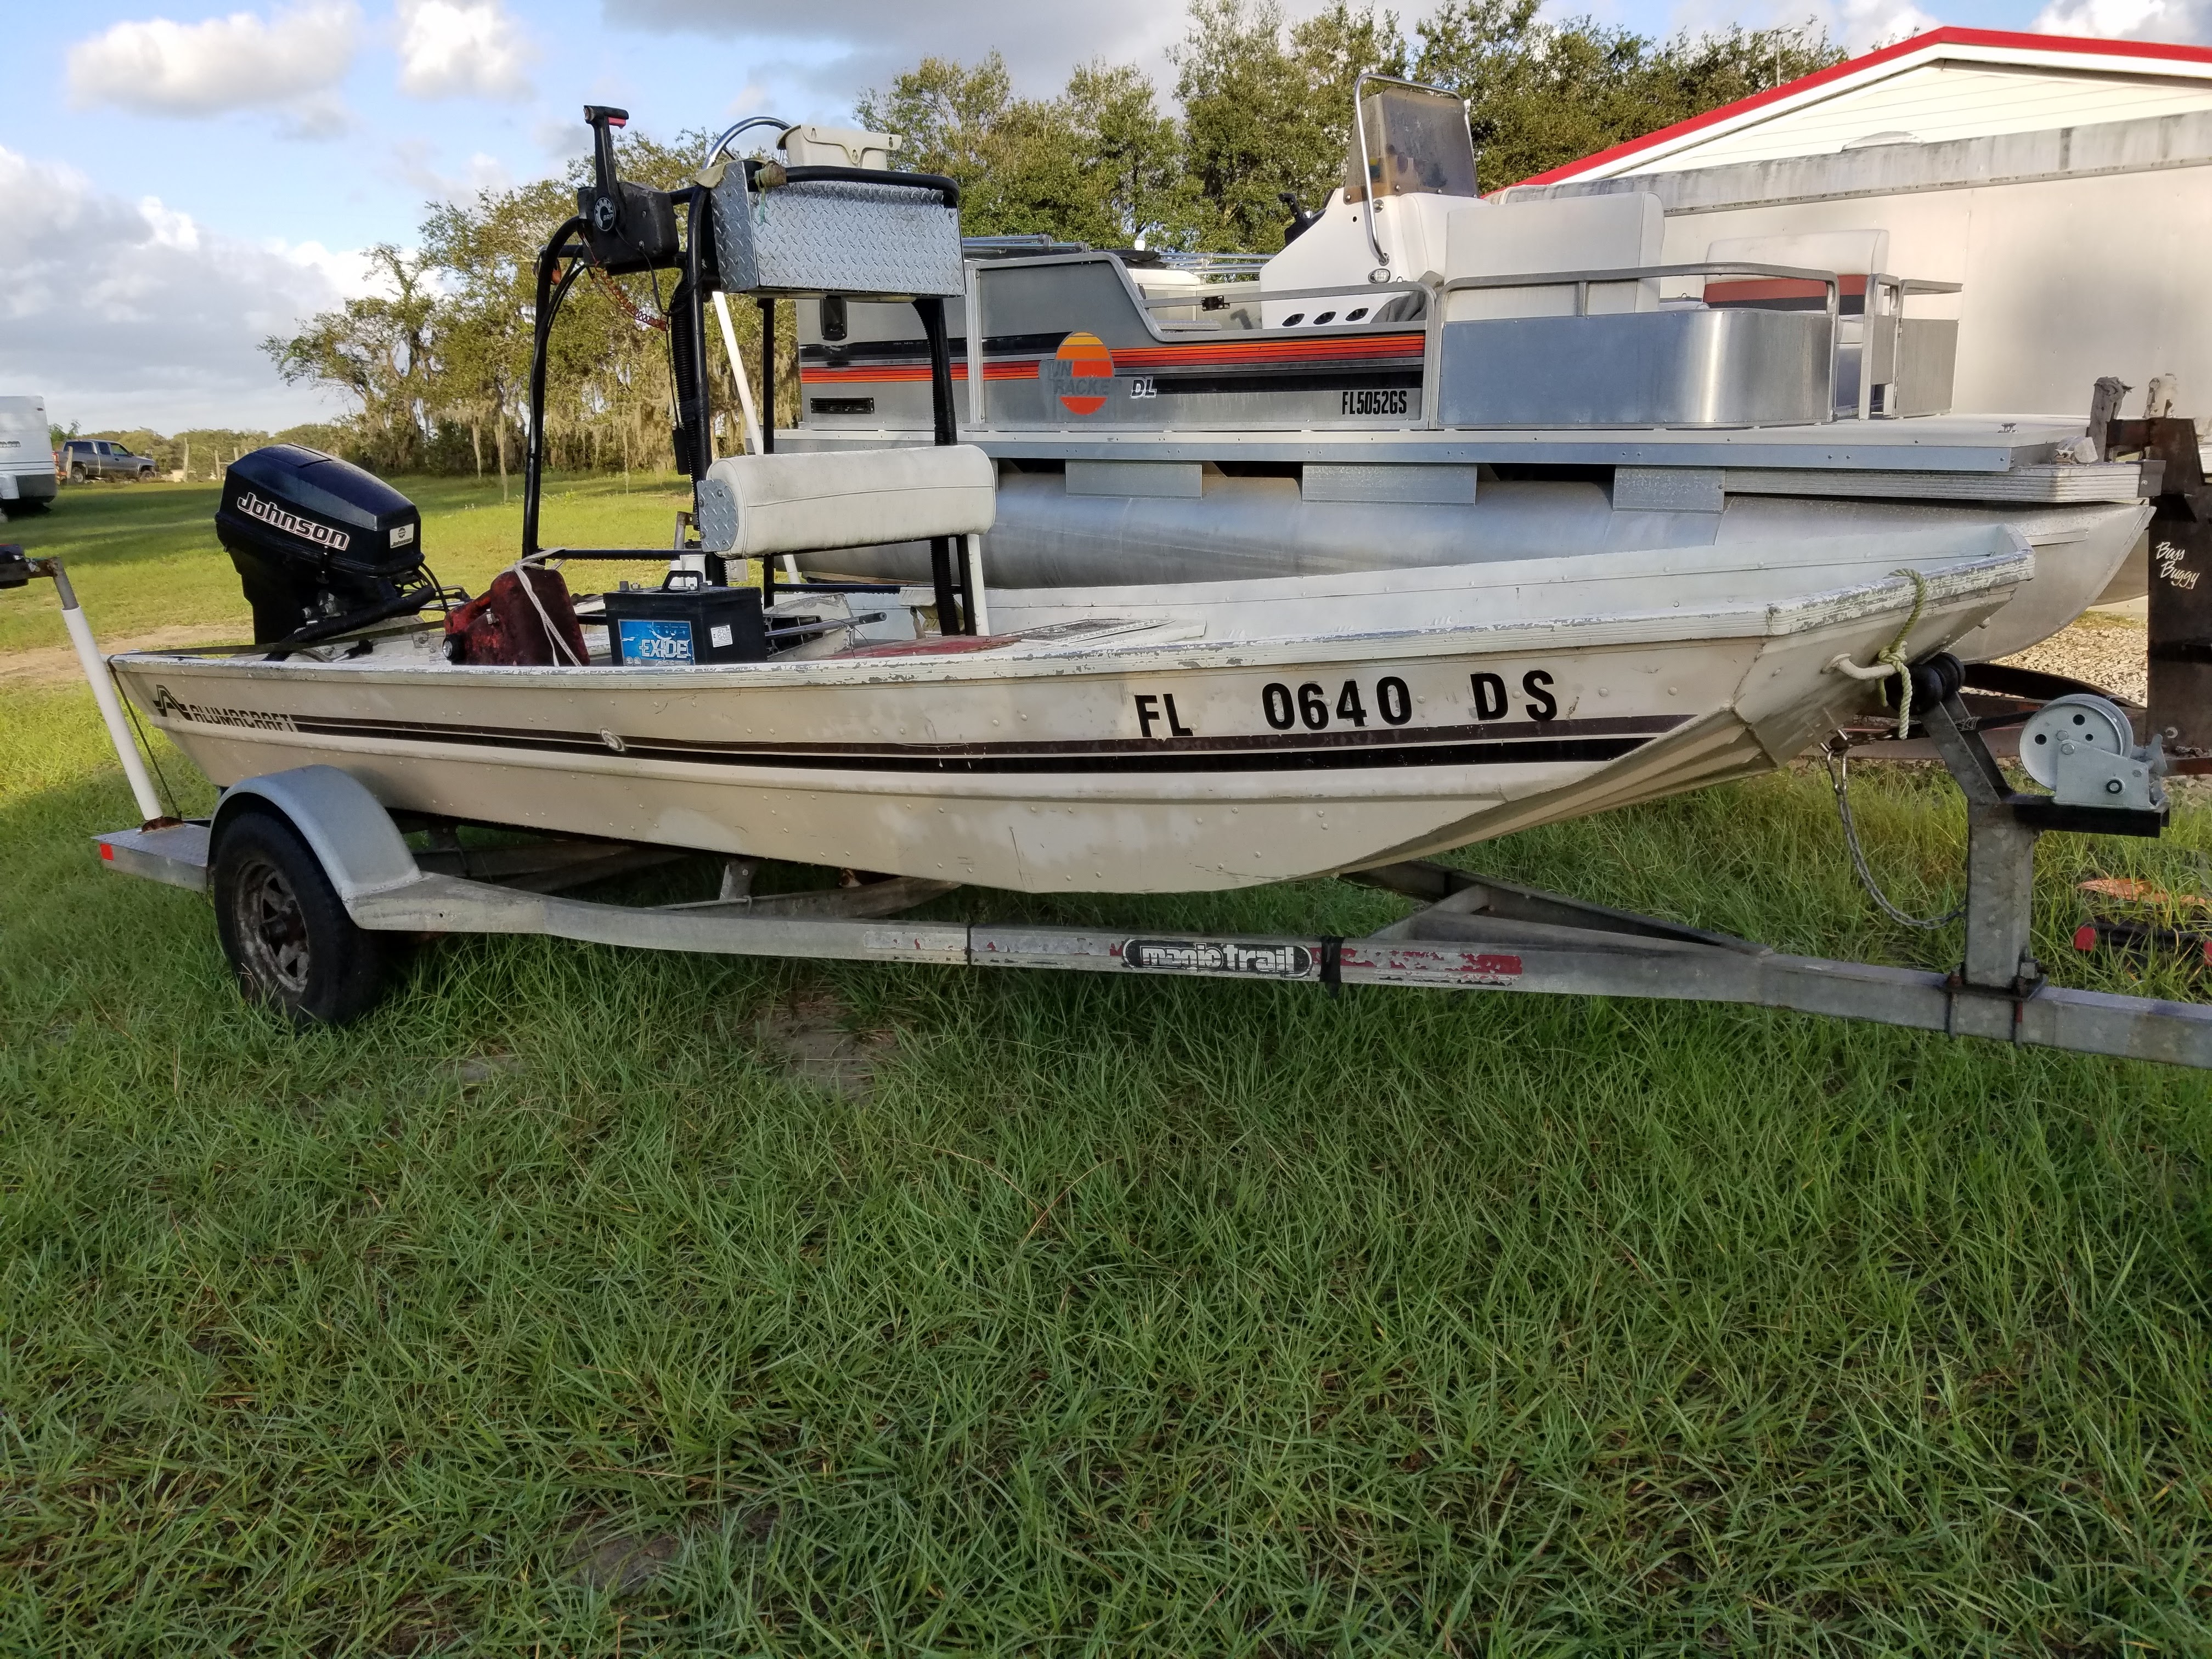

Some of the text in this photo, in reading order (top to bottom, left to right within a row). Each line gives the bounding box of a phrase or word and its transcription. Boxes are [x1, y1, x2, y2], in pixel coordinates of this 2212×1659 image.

[1130, 377, 1158, 399] DL
[1342, 390, 1407, 415] FL5052GS
[237, 492, 350, 551] Johnson
[2155, 541, 2185, 561] Bass
[2160, 560, 2200, 590] Buggy
[639, 639, 688, 659] EXIDE
[1134, 669, 1558, 738] FL 0640 DS
[189, 704, 294, 732] ALUMACRAFT
